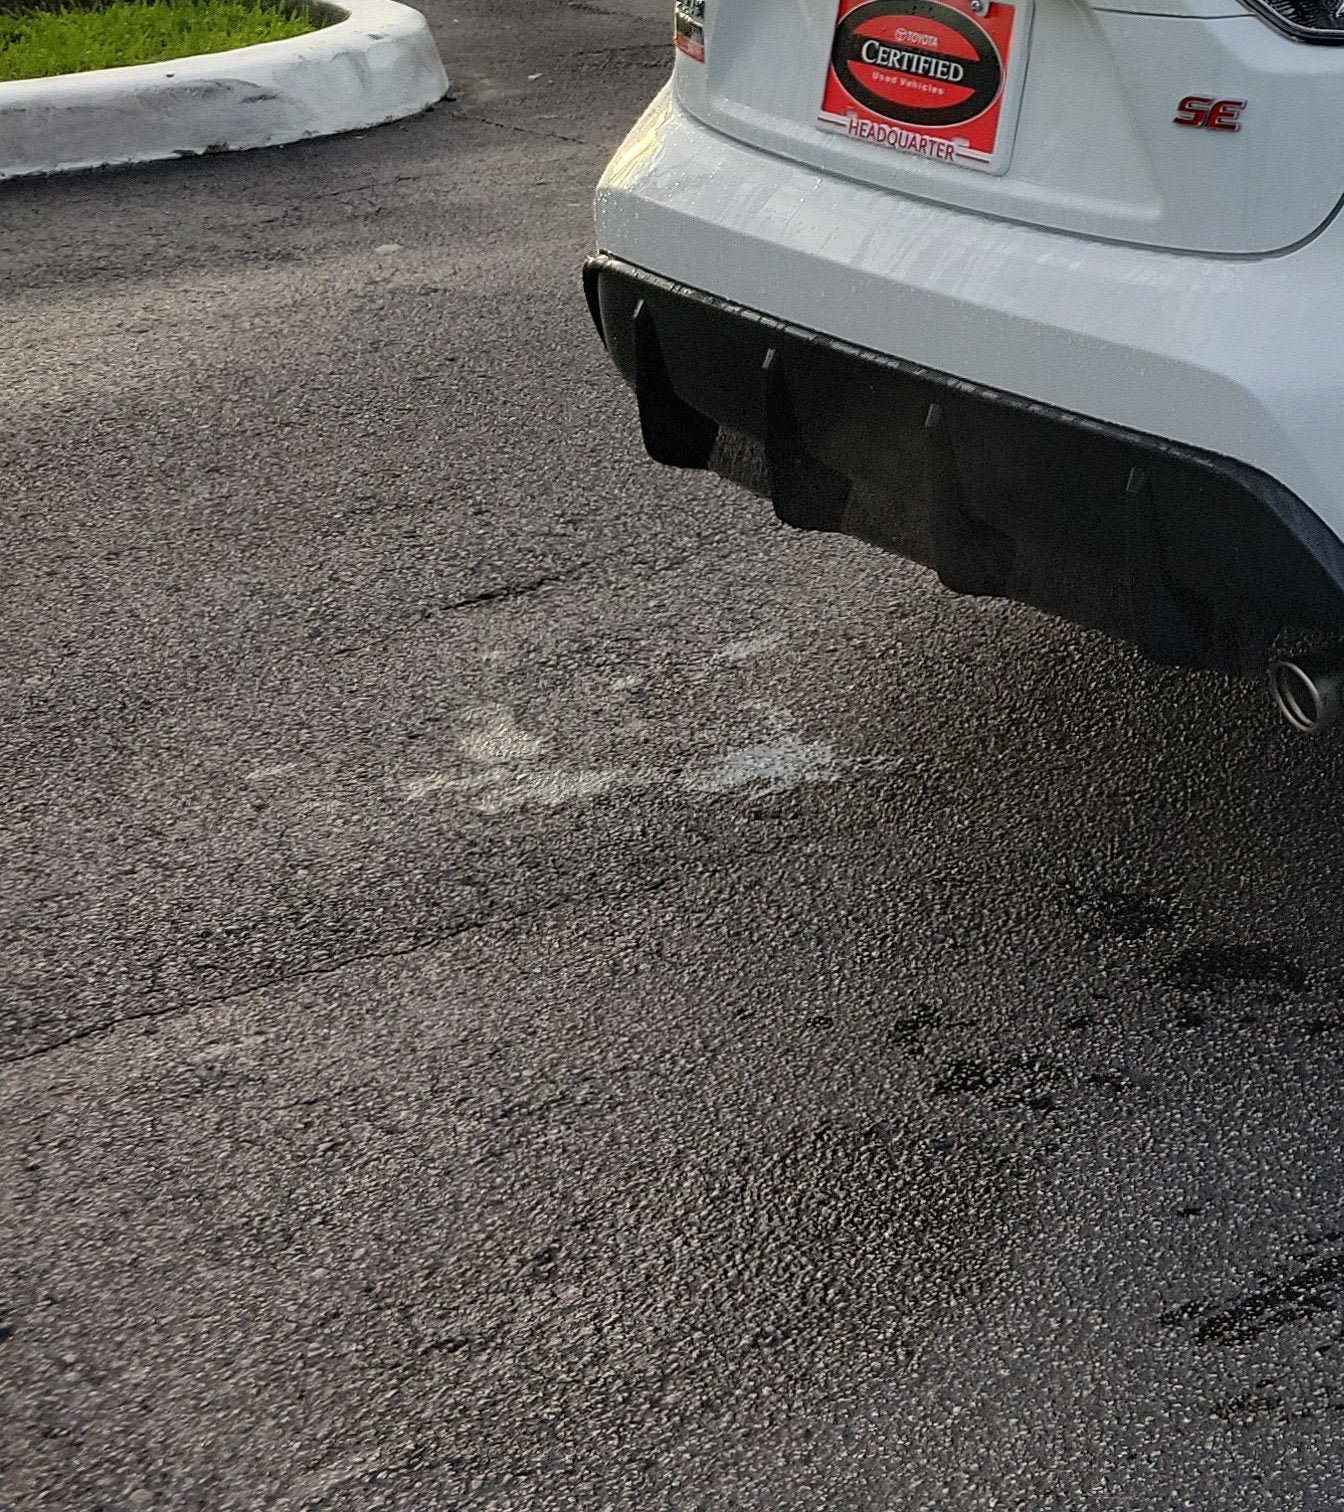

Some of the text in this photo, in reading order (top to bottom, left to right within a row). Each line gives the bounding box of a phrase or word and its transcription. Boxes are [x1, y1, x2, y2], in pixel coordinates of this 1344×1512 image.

[906, 31, 938, 47] TOYOTA
[872, 71, 945, 96] Used Vehicles
[1173, 95, 1247, 132] SE
[849, 118, 955, 161] HEADQUARTER
